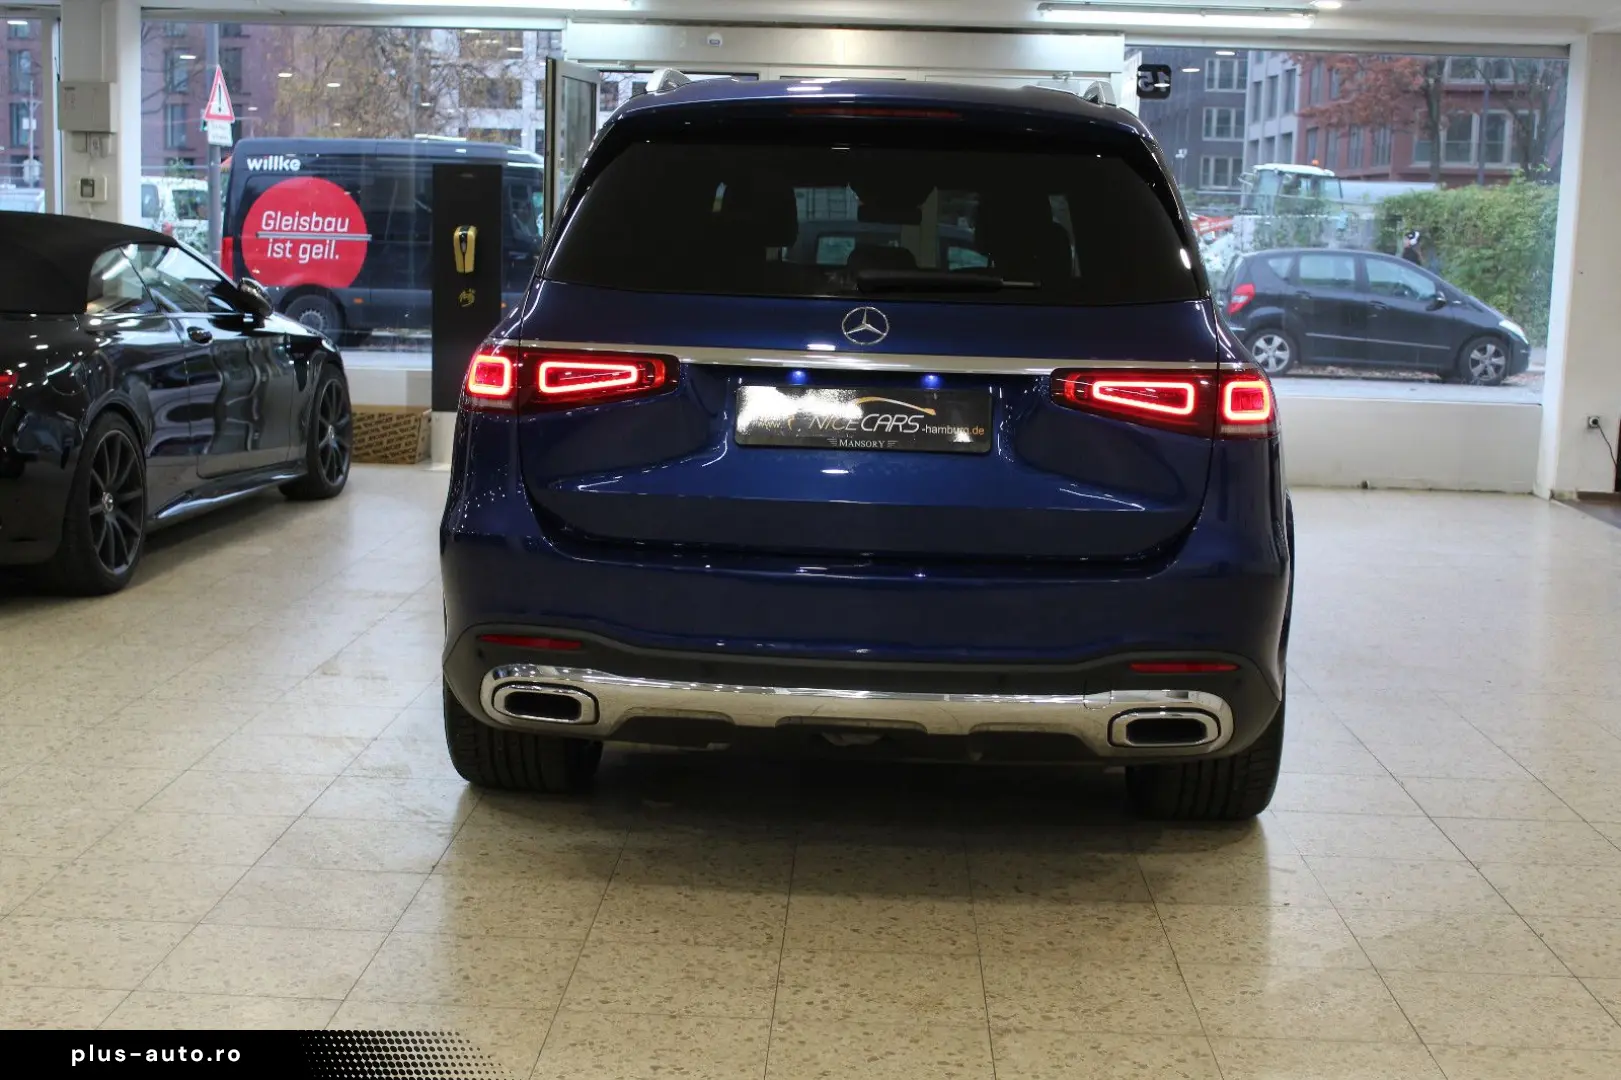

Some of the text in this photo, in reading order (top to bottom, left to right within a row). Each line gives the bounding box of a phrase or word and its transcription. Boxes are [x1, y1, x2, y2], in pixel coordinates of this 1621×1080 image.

[247, 155, 301, 171] willke
[261, 211, 349, 233] Gleisbau
[267, 239, 340, 264] ist geil.
[839, 438, 886, 449] MANSORY
